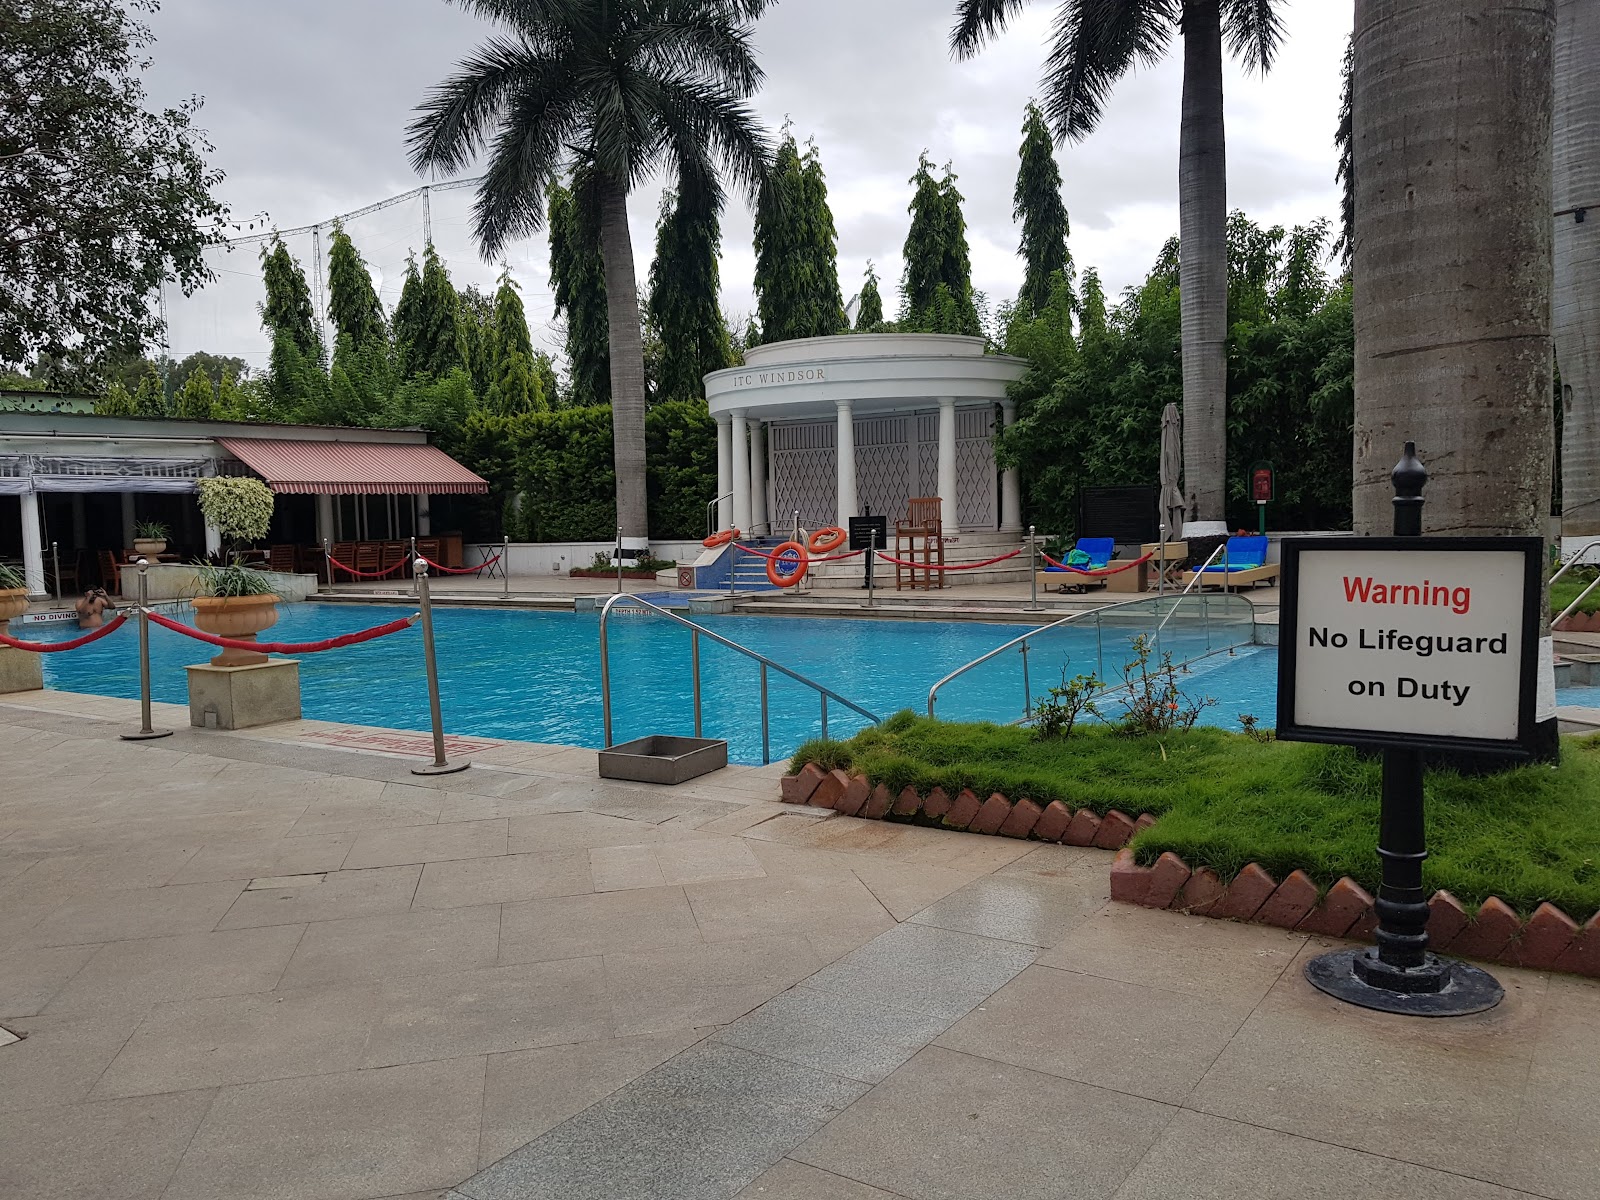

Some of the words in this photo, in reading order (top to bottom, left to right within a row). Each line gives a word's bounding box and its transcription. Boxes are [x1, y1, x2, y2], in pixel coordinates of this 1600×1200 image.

[733, 375, 752, 387] ITC
[759, 368, 825, 384] WINDSOR
[1343, 576, 1471, 615] Warning
[48, 612, 77, 620] DIVING
[1309, 627, 1348, 648] No
[1359, 628, 1508, 657] Lifeguard
[1347, 679, 1385, 697] on
[1397, 677, 1471, 707] Duty
